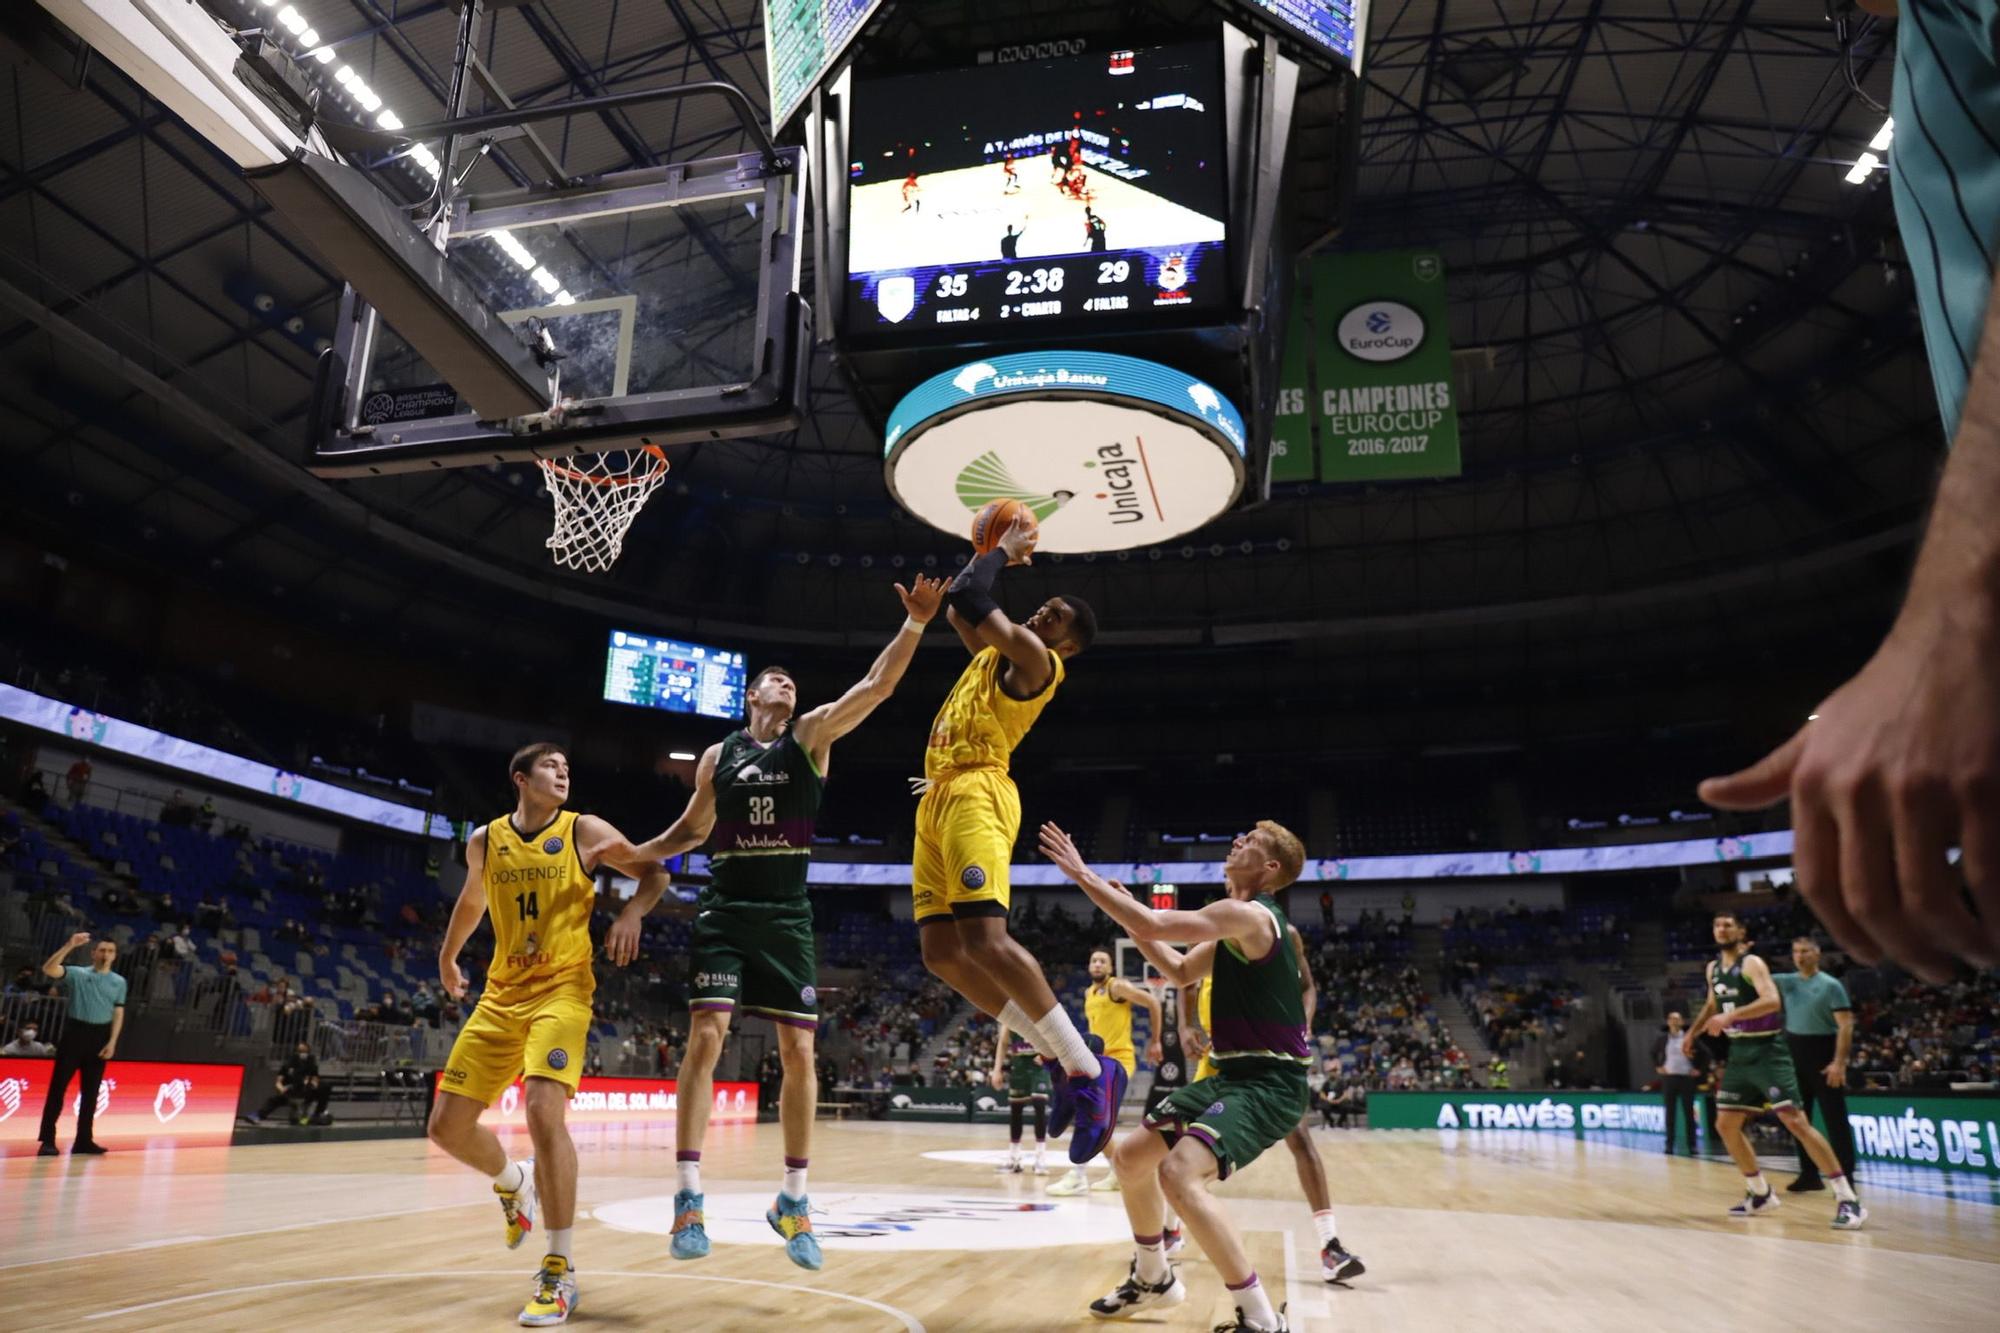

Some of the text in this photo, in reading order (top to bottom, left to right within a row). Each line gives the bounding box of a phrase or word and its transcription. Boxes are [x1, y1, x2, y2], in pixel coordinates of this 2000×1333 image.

[998, 39, 1087, 63] MONDO
[1005, 267, 1065, 296] 2:38
[1097, 260, 1130, 284] 29
[936, 273, 968, 298] 35
[970, 308, 980, 321] 4
[1000, 305, 1011, 319] 2
[1021, 300, 1062, 317] CUARTO
[1083, 296, 1129, 312] 4 FALTAS
[1350, 336, 1414, 350] EuroCup
[395, 396, 454, 411] CHAMPIONS
[1323, 382, 1449, 416] CAMPEONES
[394, 408, 425, 418] LEAGUE
[1332, 410, 1442, 435] EUROCUP
[1348, 435, 1429, 456] 2016/2017
[1085, 442, 1144, 525] Unicaja
[749, 796, 775, 825] 32
[491, 865, 567, 885] OOSTENDE
[515, 891, 540, 921] 14
[1152, 894, 1173, 910] 10
[571, 1092, 607, 1111] COSTA
[607, 1093, 628, 1111] DEL
[628, 1093, 649, 1111] SOL
[1437, 1103, 1459, 1128] A
[1462, 1098, 1575, 1128] TRAVÉS
[1580, 1103, 1621, 1129] DE
[1848, 1107, 1940, 1163] TRAVÉS
[1941, 1120, 1987, 1167] DE
